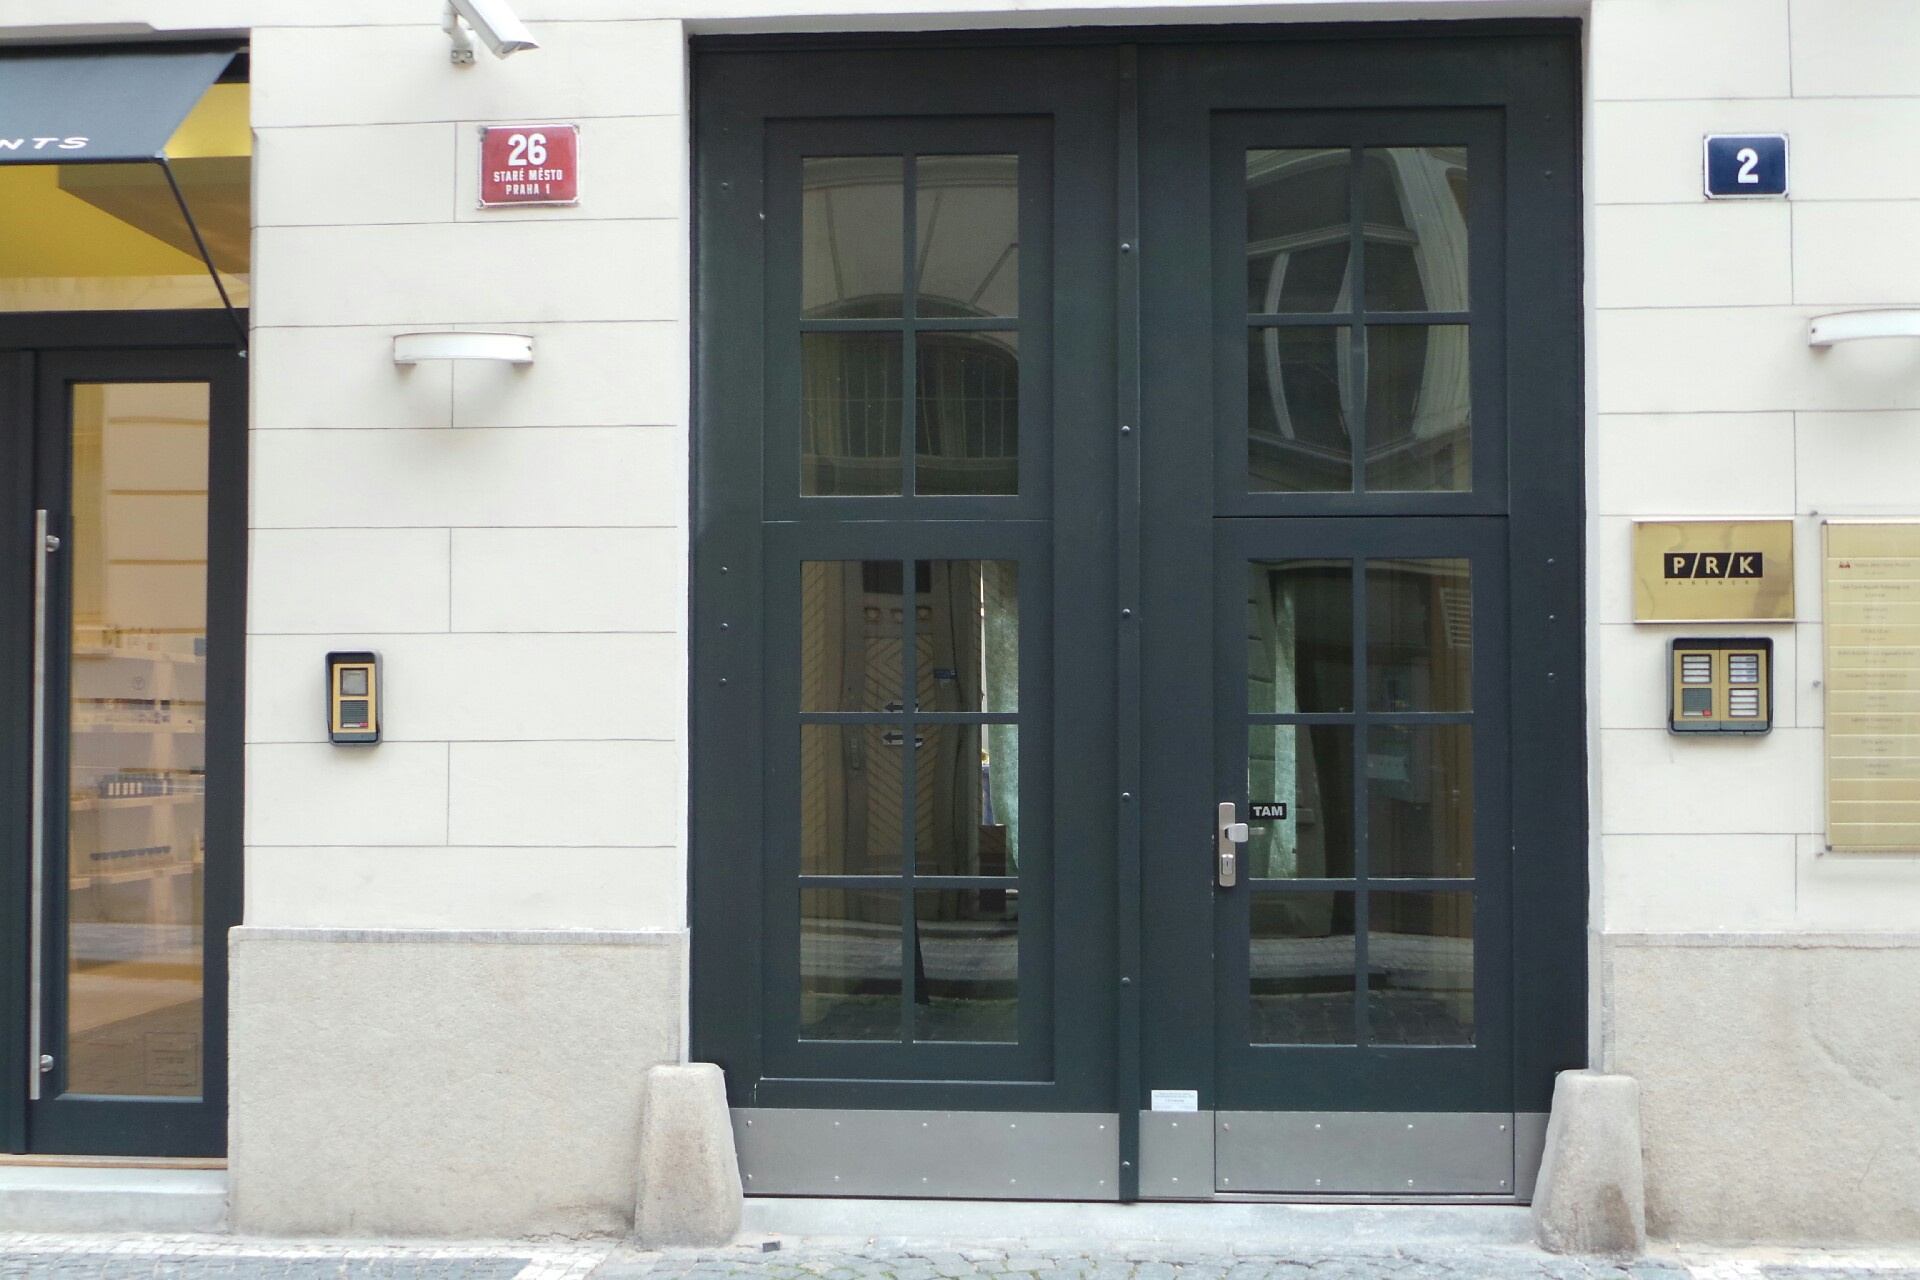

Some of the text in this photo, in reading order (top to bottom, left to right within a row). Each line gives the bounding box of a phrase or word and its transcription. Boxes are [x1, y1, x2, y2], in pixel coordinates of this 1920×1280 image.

[0, 136, 88, 149] NTS
[507, 133, 547, 165] 26
[1736, 147, 1759, 184] 2
[493, 167, 563, 182] STARÉ MĚSTO
[505, 183, 550, 195] PRAHA 1
[1252, 806, 1283, 816] TAM
